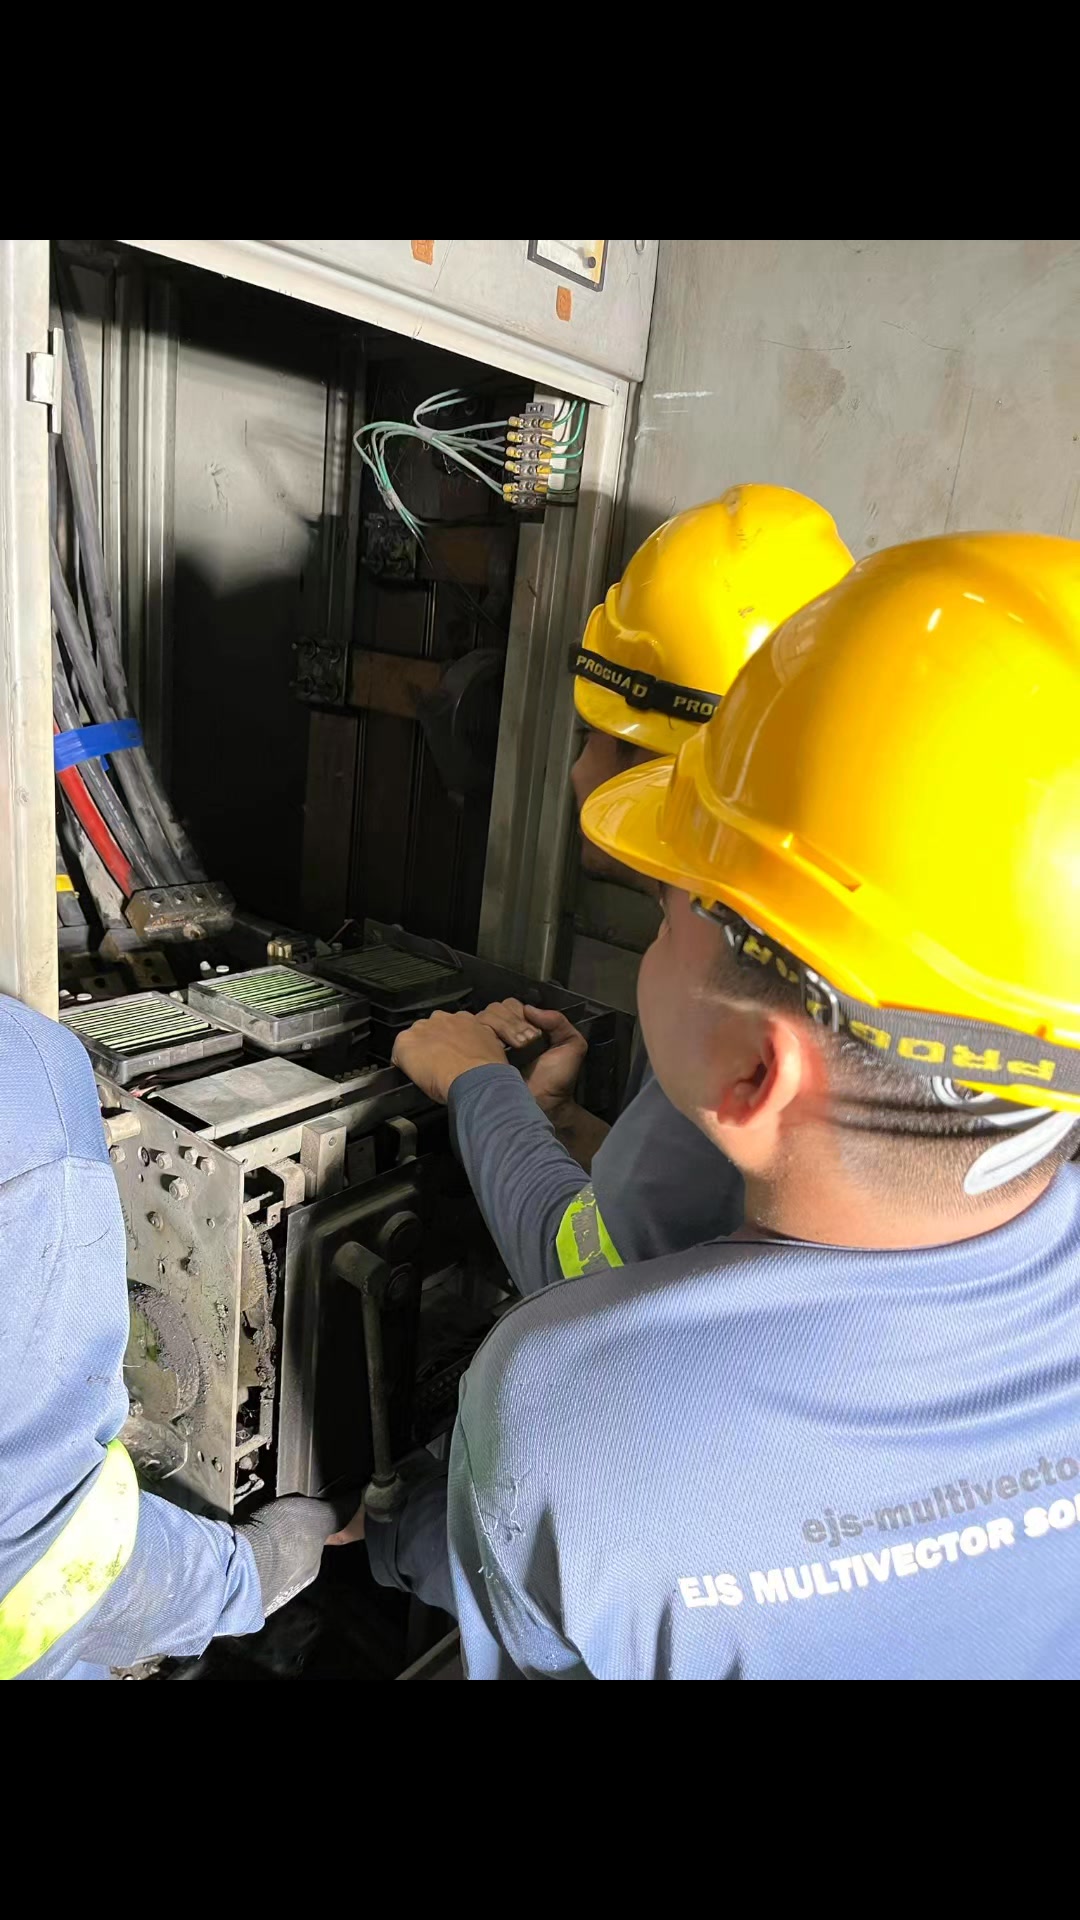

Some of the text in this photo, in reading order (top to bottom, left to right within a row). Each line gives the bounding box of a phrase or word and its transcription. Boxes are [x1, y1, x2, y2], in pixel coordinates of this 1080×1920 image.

[673, 695, 718, 716] PRO
[802, 1456, 1080, 1547] ejs-multivecto
[678, 1573, 743, 1608] EJS
[749, 1517, 1015, 1605] MULTIVECTOR
